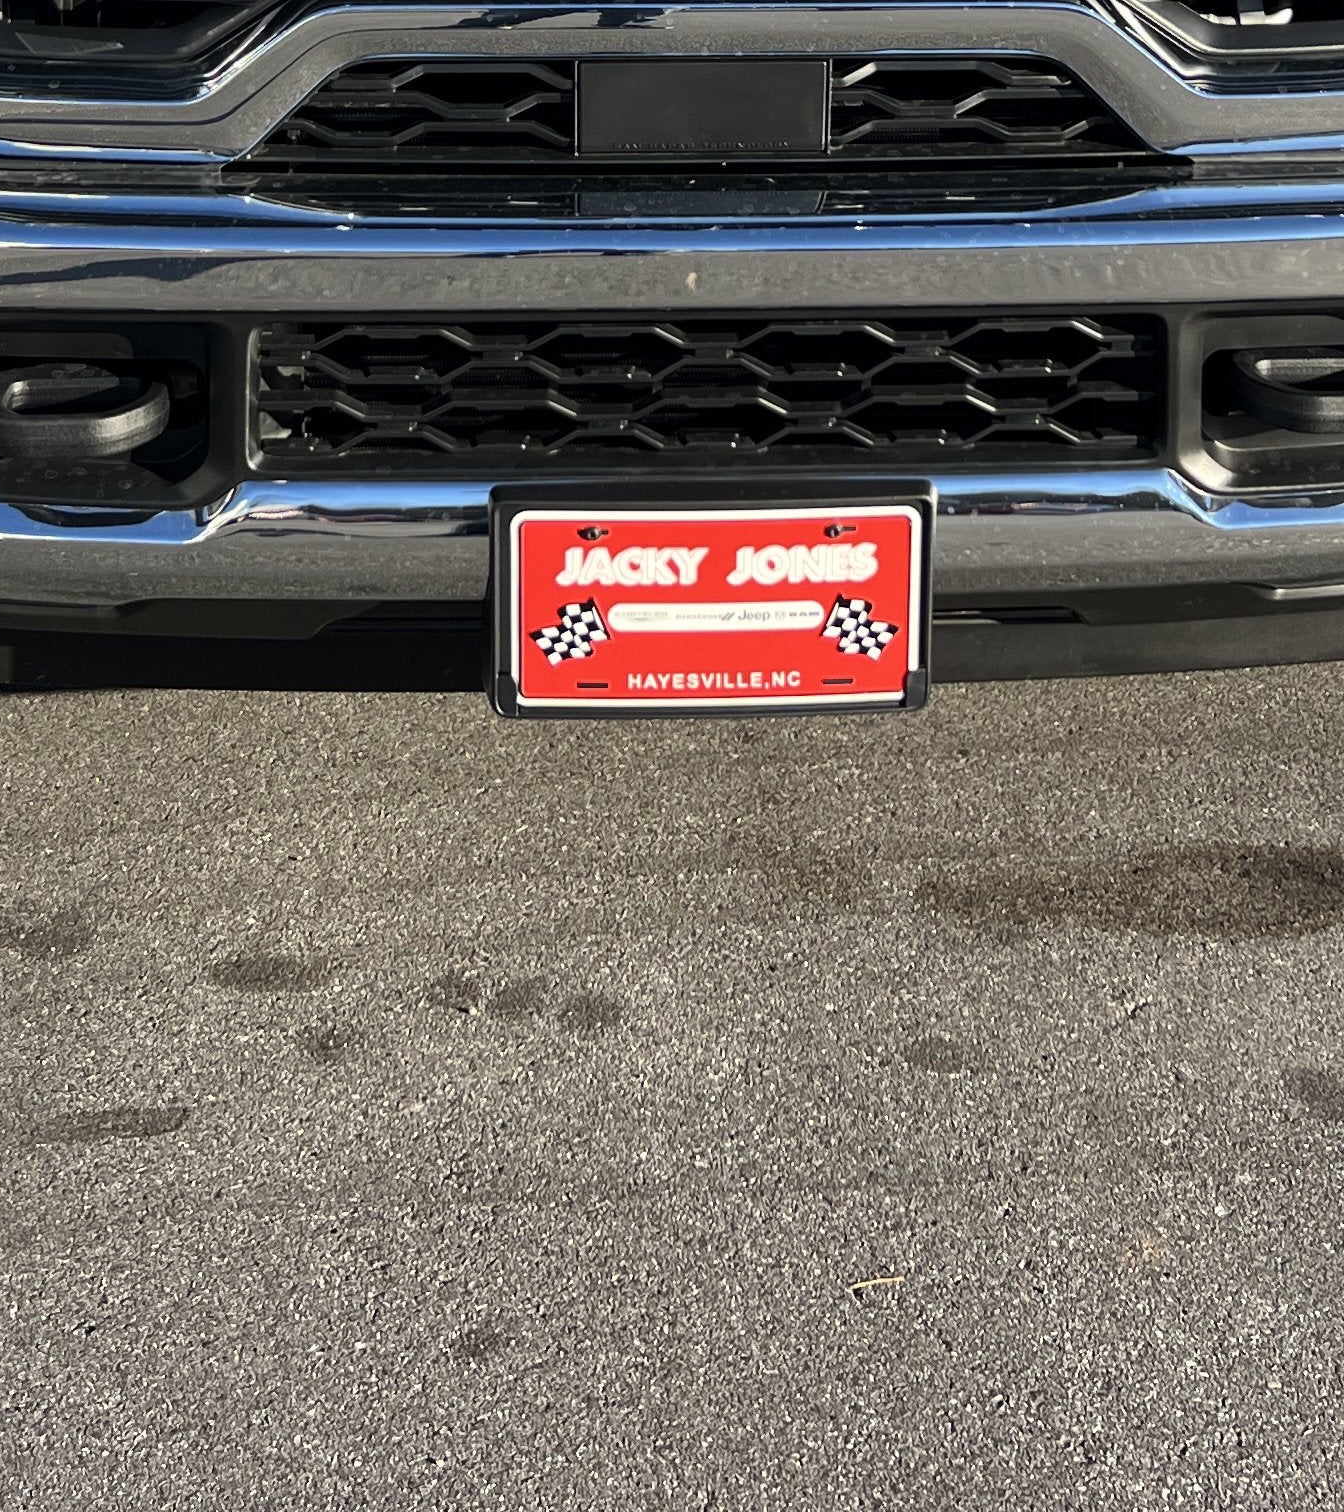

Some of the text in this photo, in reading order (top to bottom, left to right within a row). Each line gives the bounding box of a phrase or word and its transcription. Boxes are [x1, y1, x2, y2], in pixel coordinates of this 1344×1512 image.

[556, 542, 878, 586] JACKY JONES
[737, 608, 771, 622] Jeep
